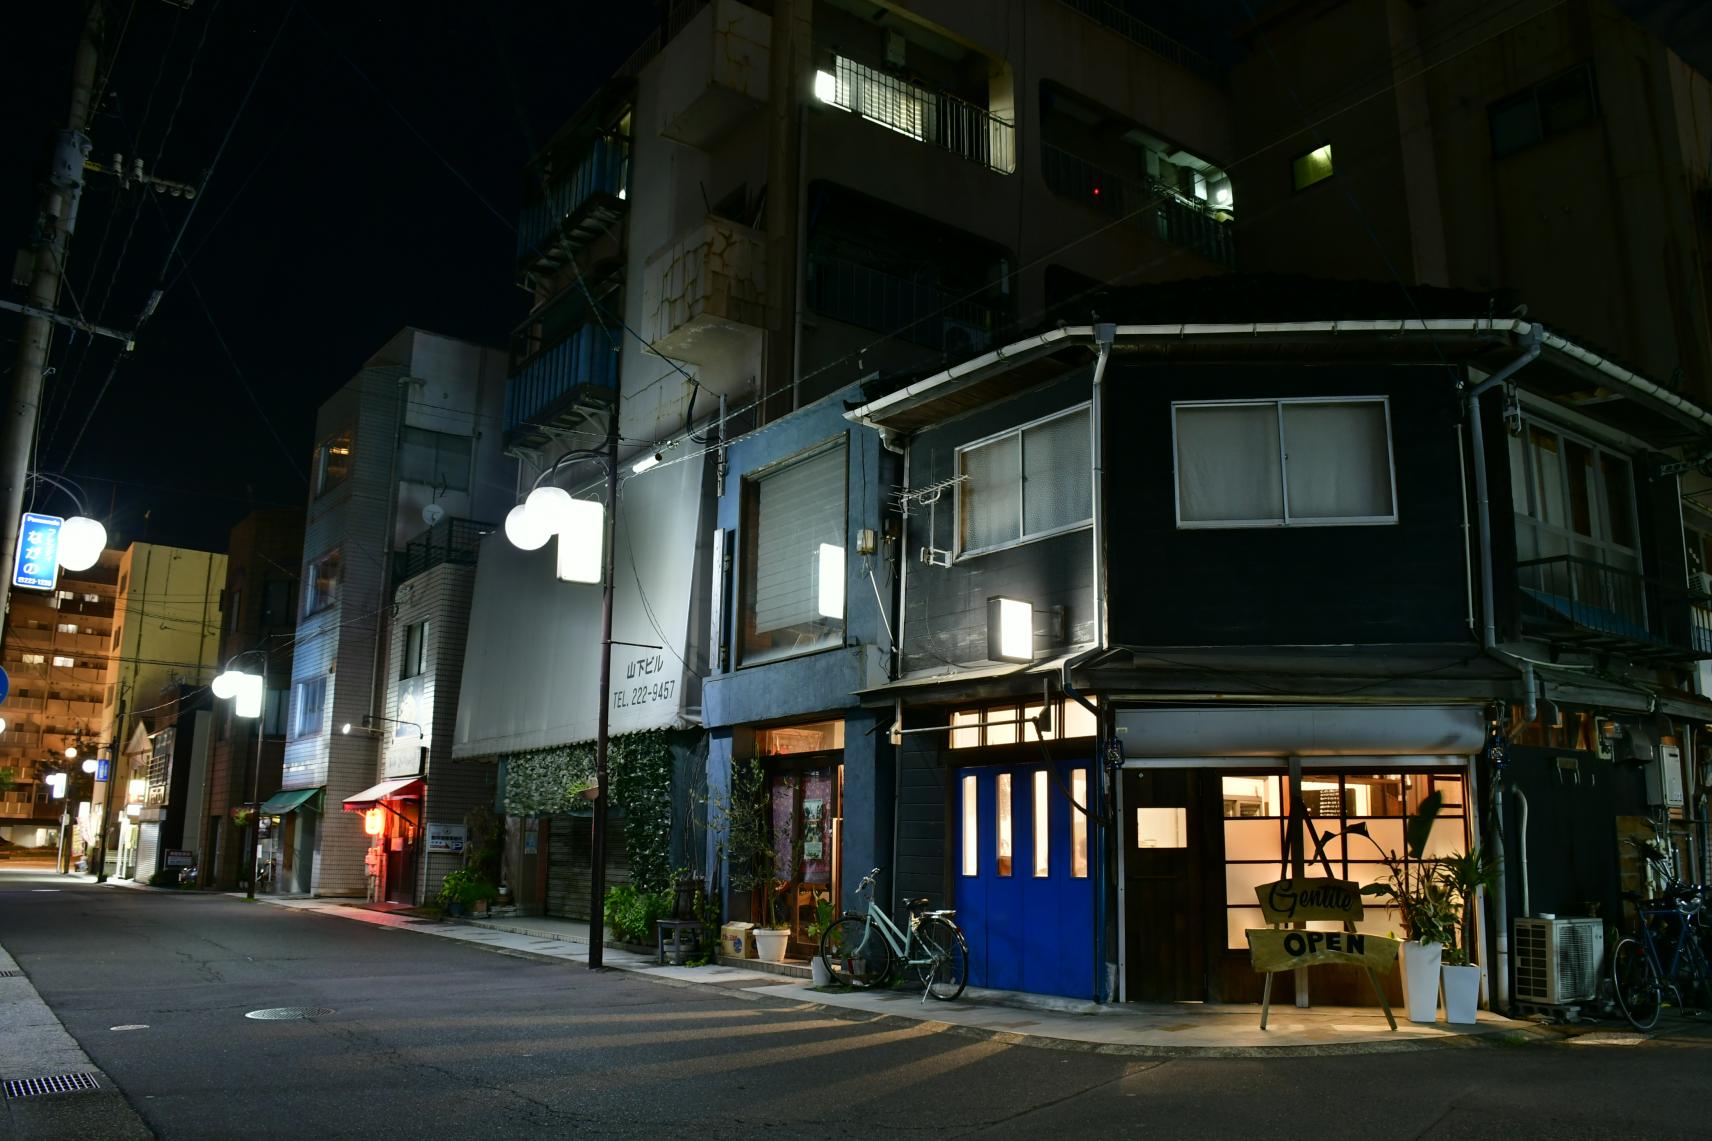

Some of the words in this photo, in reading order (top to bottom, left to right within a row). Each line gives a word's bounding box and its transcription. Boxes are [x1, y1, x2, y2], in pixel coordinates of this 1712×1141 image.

[626, 654, 664, 679] 山下ビル
[631, 679, 676, 706] 222-9457
[1284, 932, 1365, 957] OPEN
